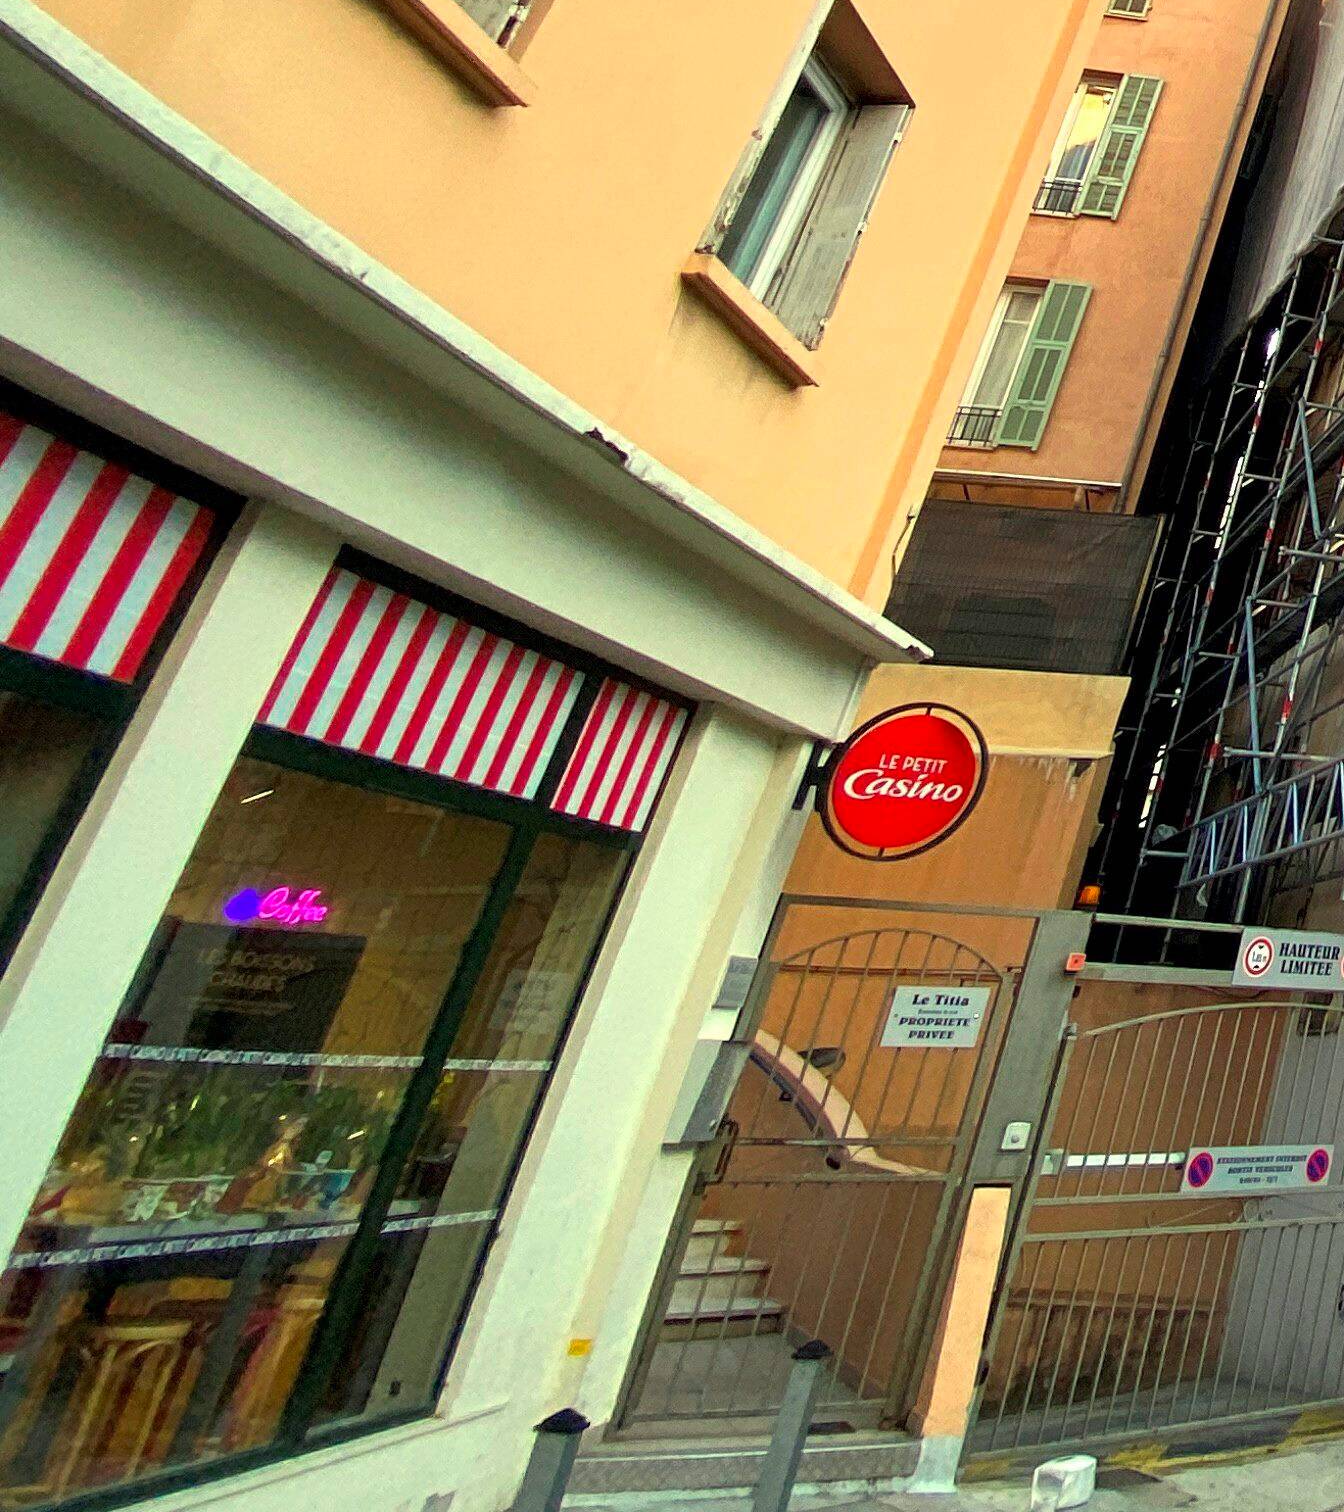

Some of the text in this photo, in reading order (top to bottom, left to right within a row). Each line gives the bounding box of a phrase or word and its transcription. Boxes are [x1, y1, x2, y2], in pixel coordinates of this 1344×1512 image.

[879, 753, 948, 774] LE PETIT
[843, 768, 963, 802] Casino
[258, 886, 328, 924] Coffee
[1279, 942, 1341, 960] HAUTEUR
[1280, 959, 1334, 976] LIMITEE
[912, 994, 930, 1006] Le
[898, 1017, 971, 1027] PROPRIETE
[907, 1030, 955, 1039] PRIVEE
